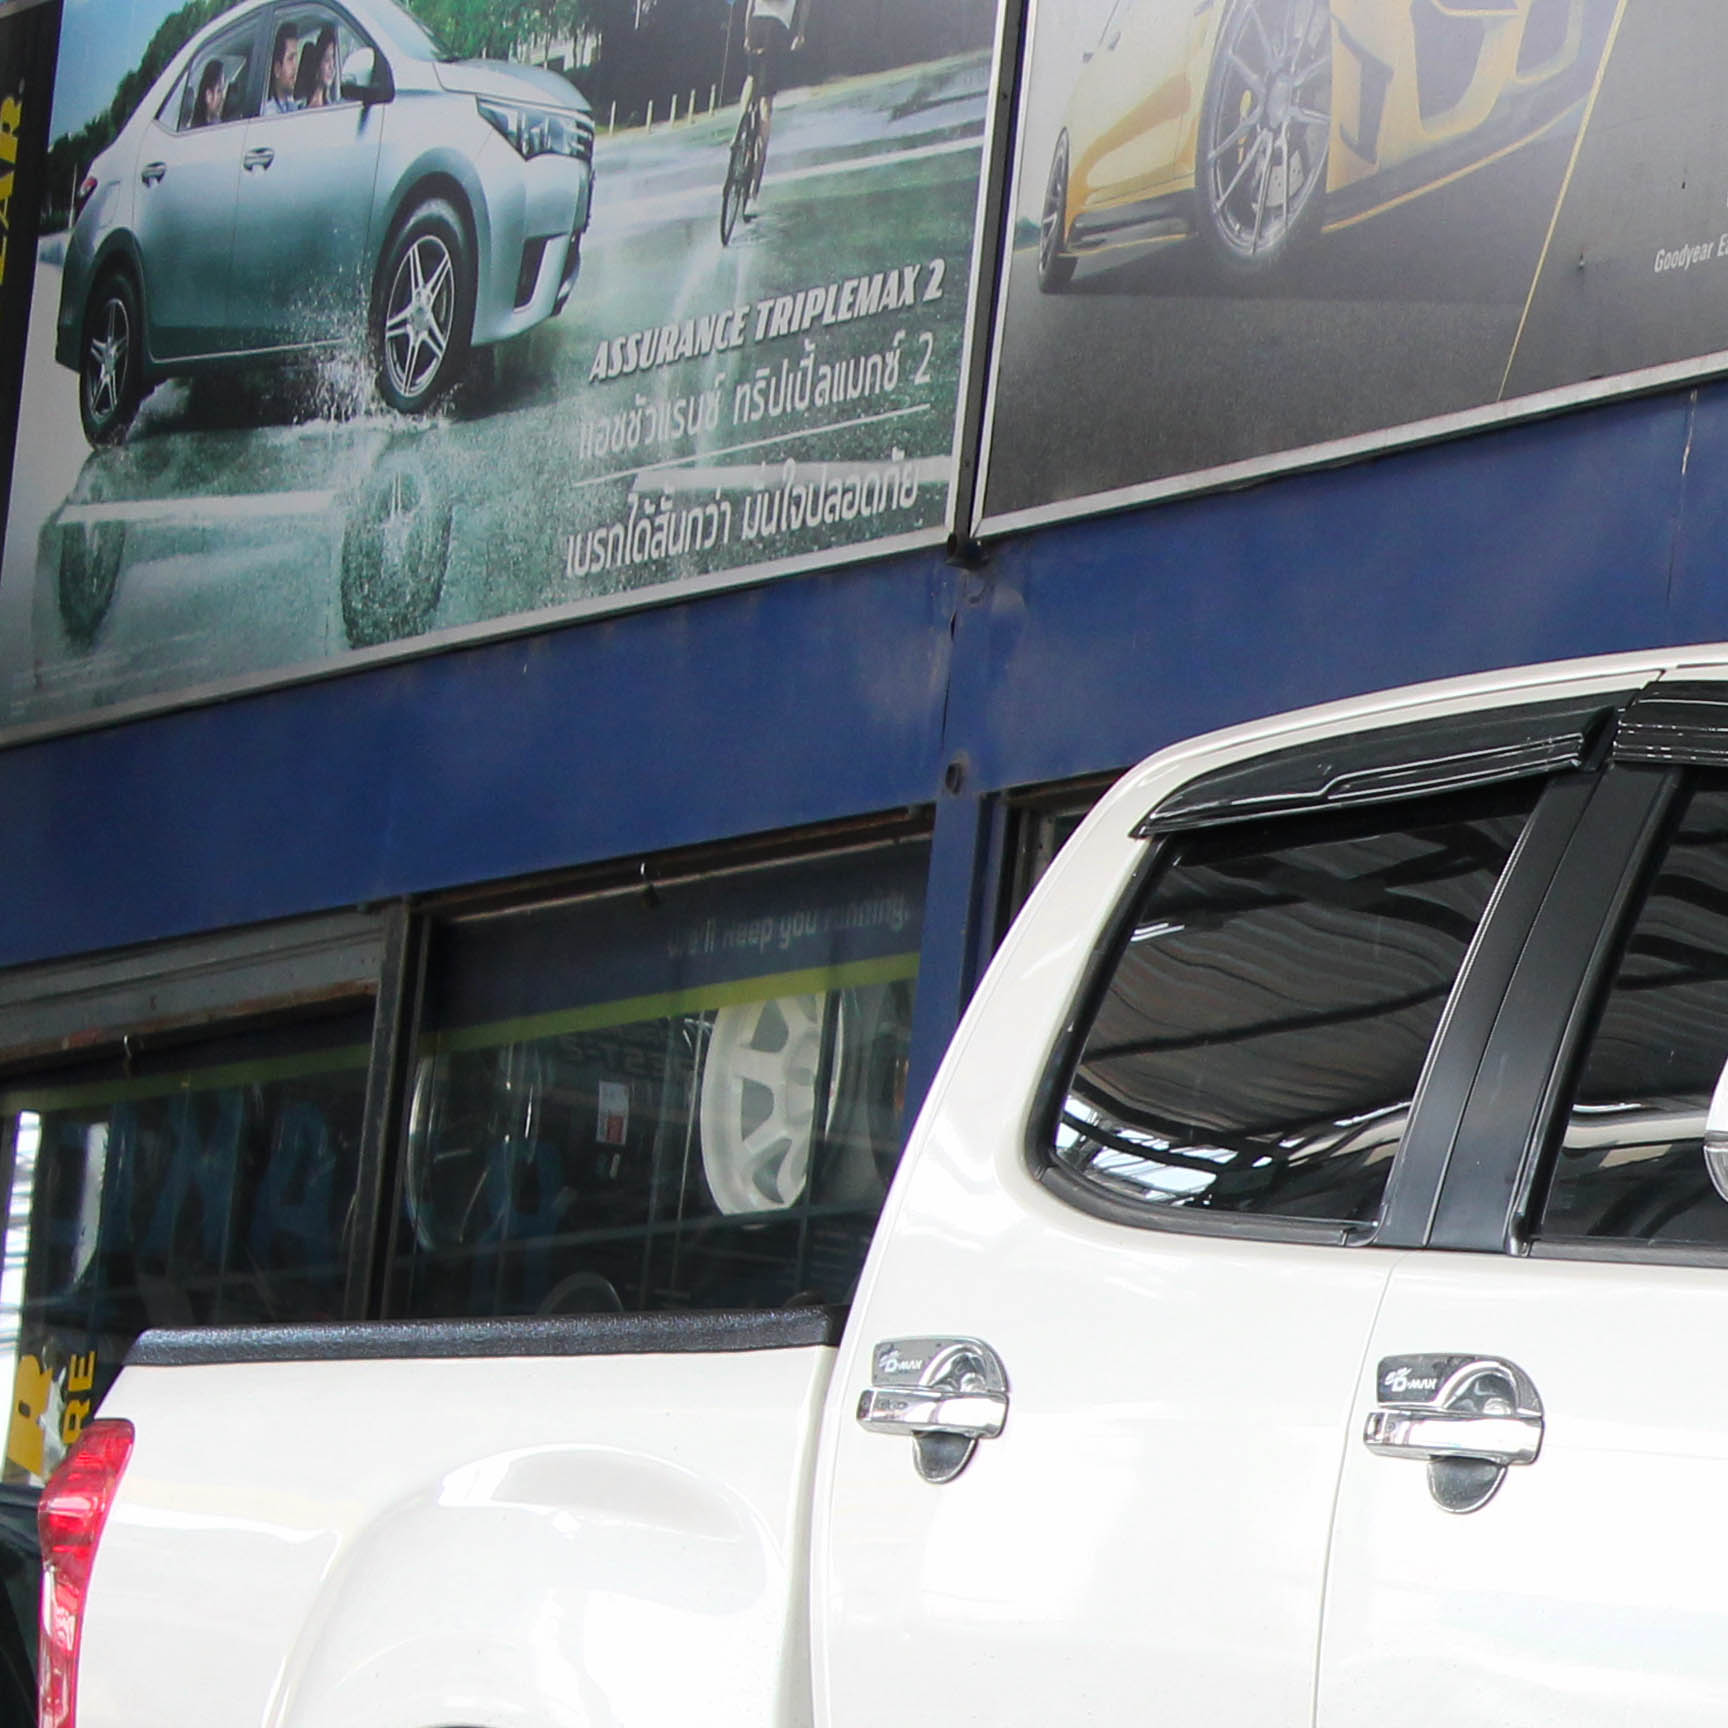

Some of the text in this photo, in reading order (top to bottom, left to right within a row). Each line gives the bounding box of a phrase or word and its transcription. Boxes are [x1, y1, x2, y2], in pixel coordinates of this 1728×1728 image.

[1653, 242, 1714, 273] Goodyear
[588, 258, 945, 384] ASSURANCE TRIPLEMAX 2
[914, 331, 934, 386] 2
